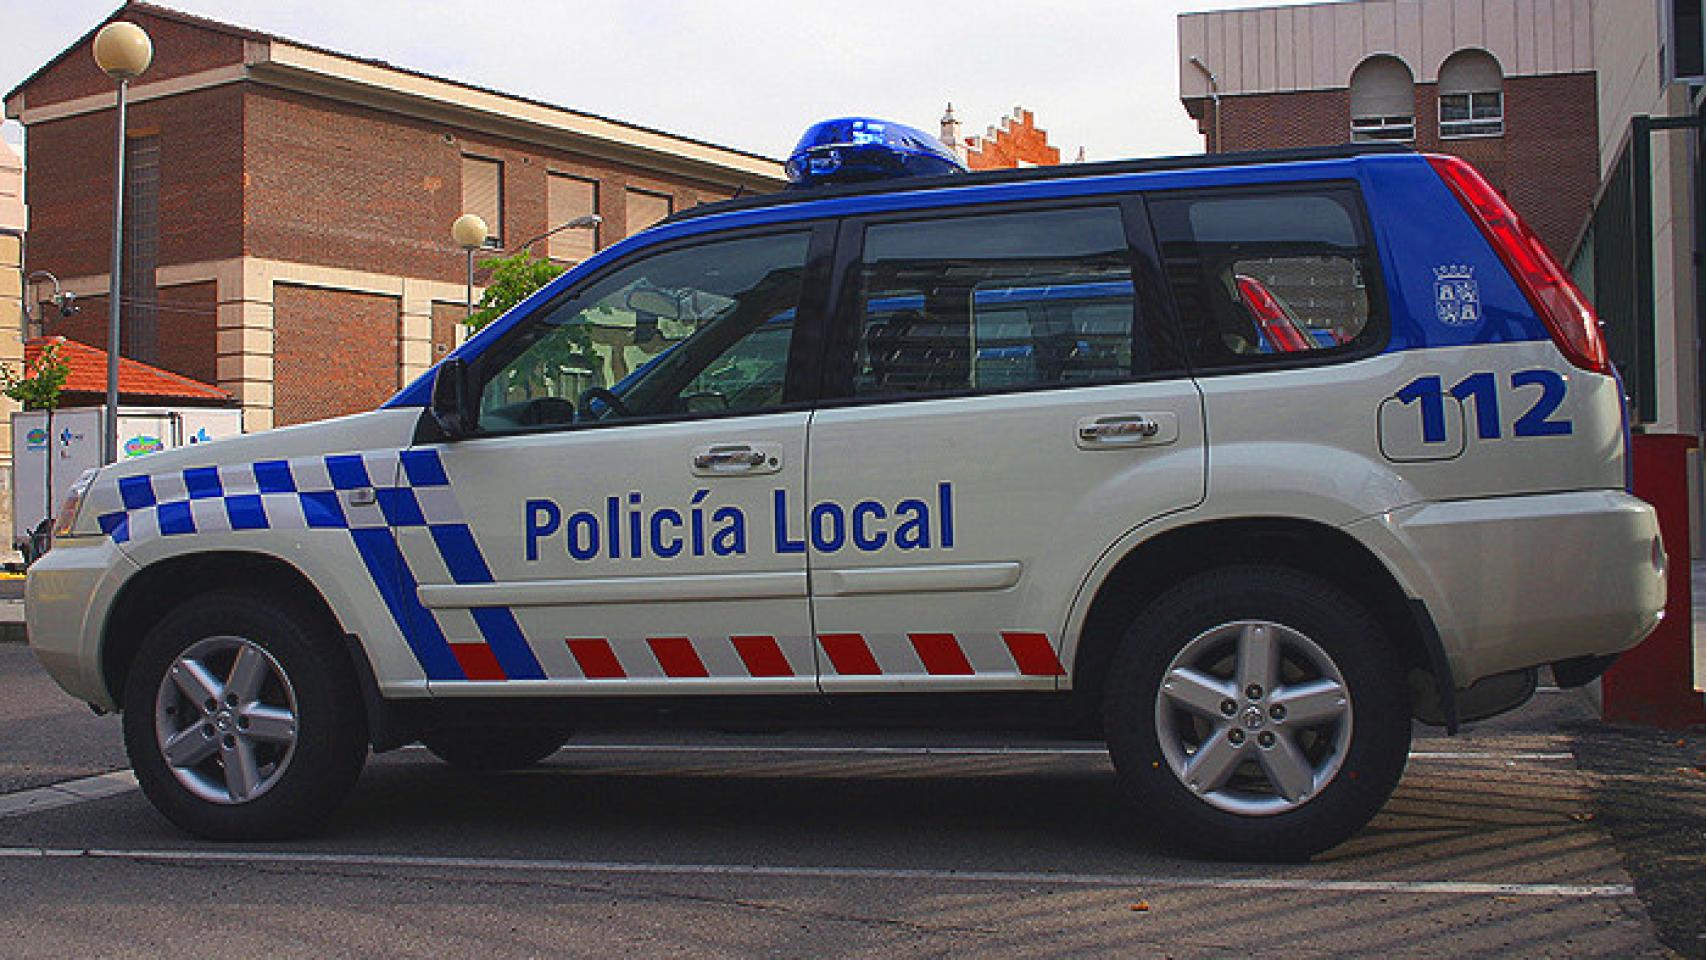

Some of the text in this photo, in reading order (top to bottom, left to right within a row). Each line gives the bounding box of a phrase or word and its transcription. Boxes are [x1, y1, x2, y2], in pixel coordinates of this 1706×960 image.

[1396, 369, 1573, 443] 112
[525, 482, 954, 561] Policía Local
